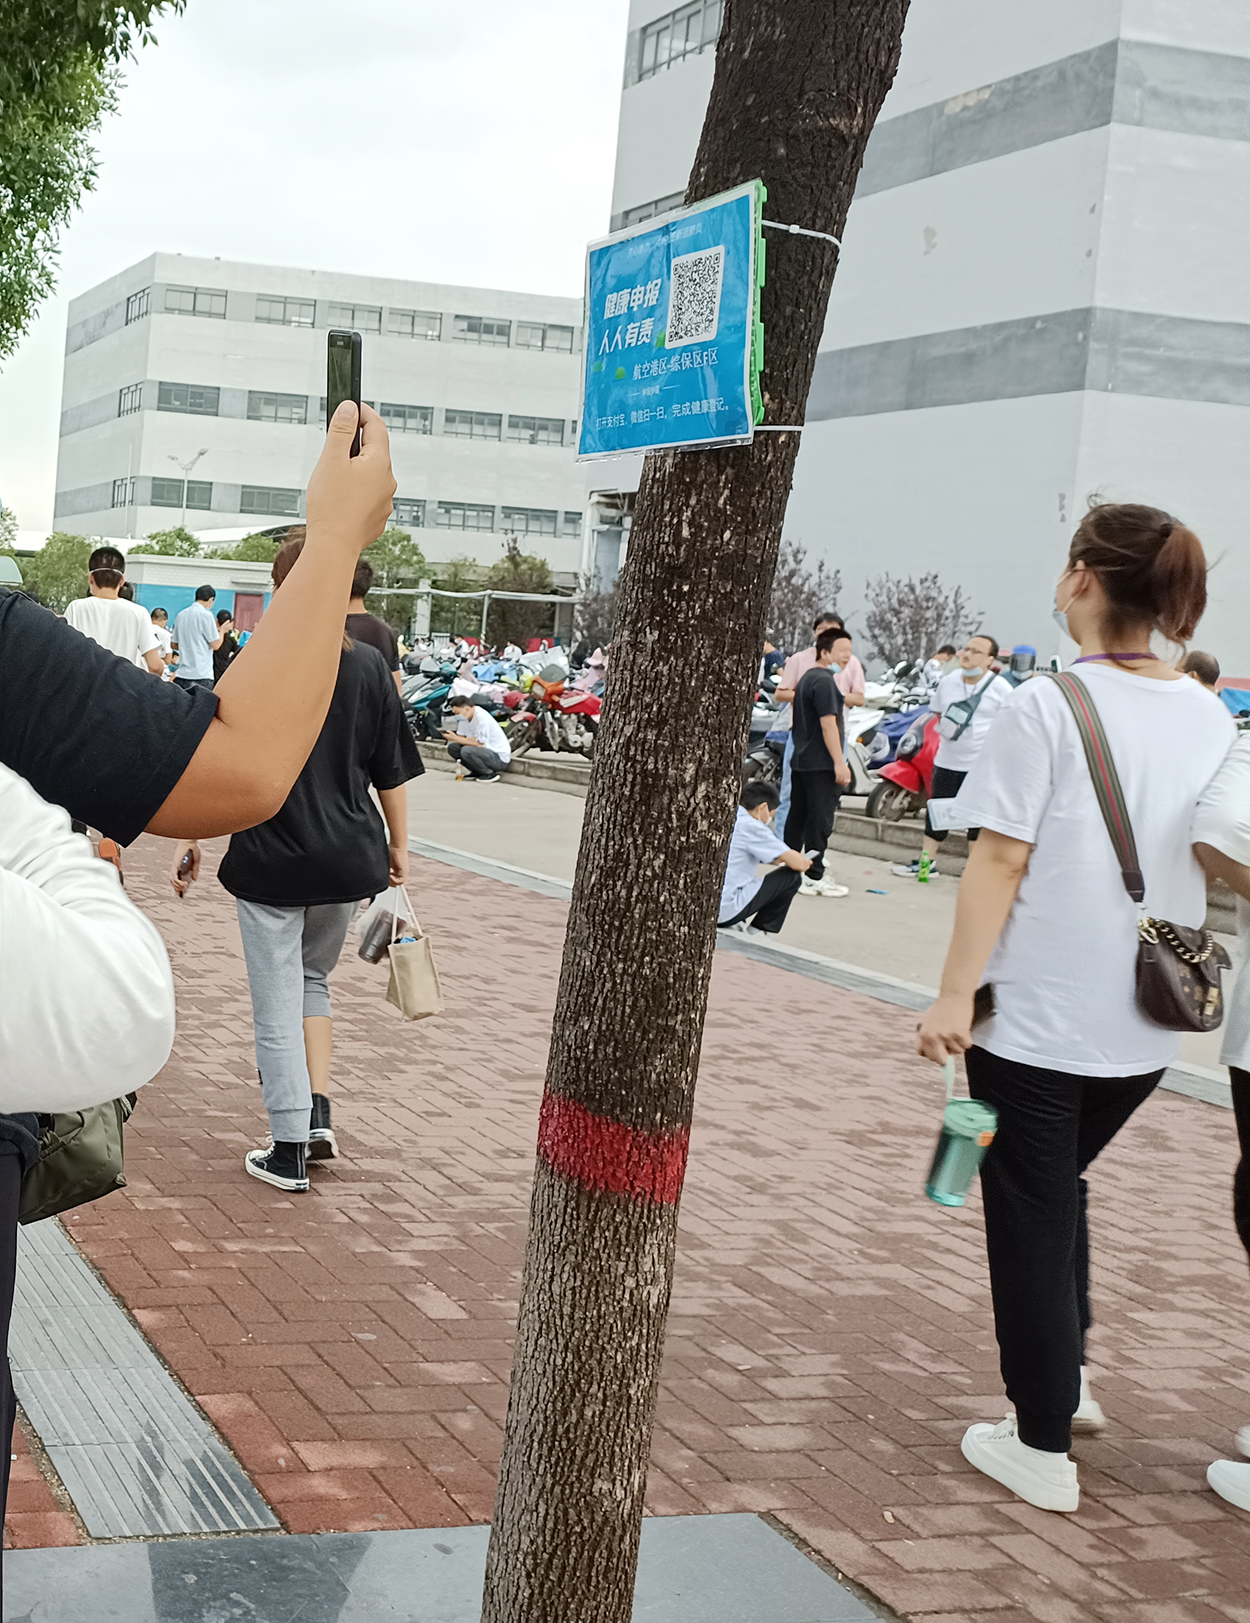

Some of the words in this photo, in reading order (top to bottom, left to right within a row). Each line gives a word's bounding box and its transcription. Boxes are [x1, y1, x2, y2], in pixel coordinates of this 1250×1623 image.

[603, 278, 661, 319] 健康申报
[599, 317, 655, 355] 人人有责
